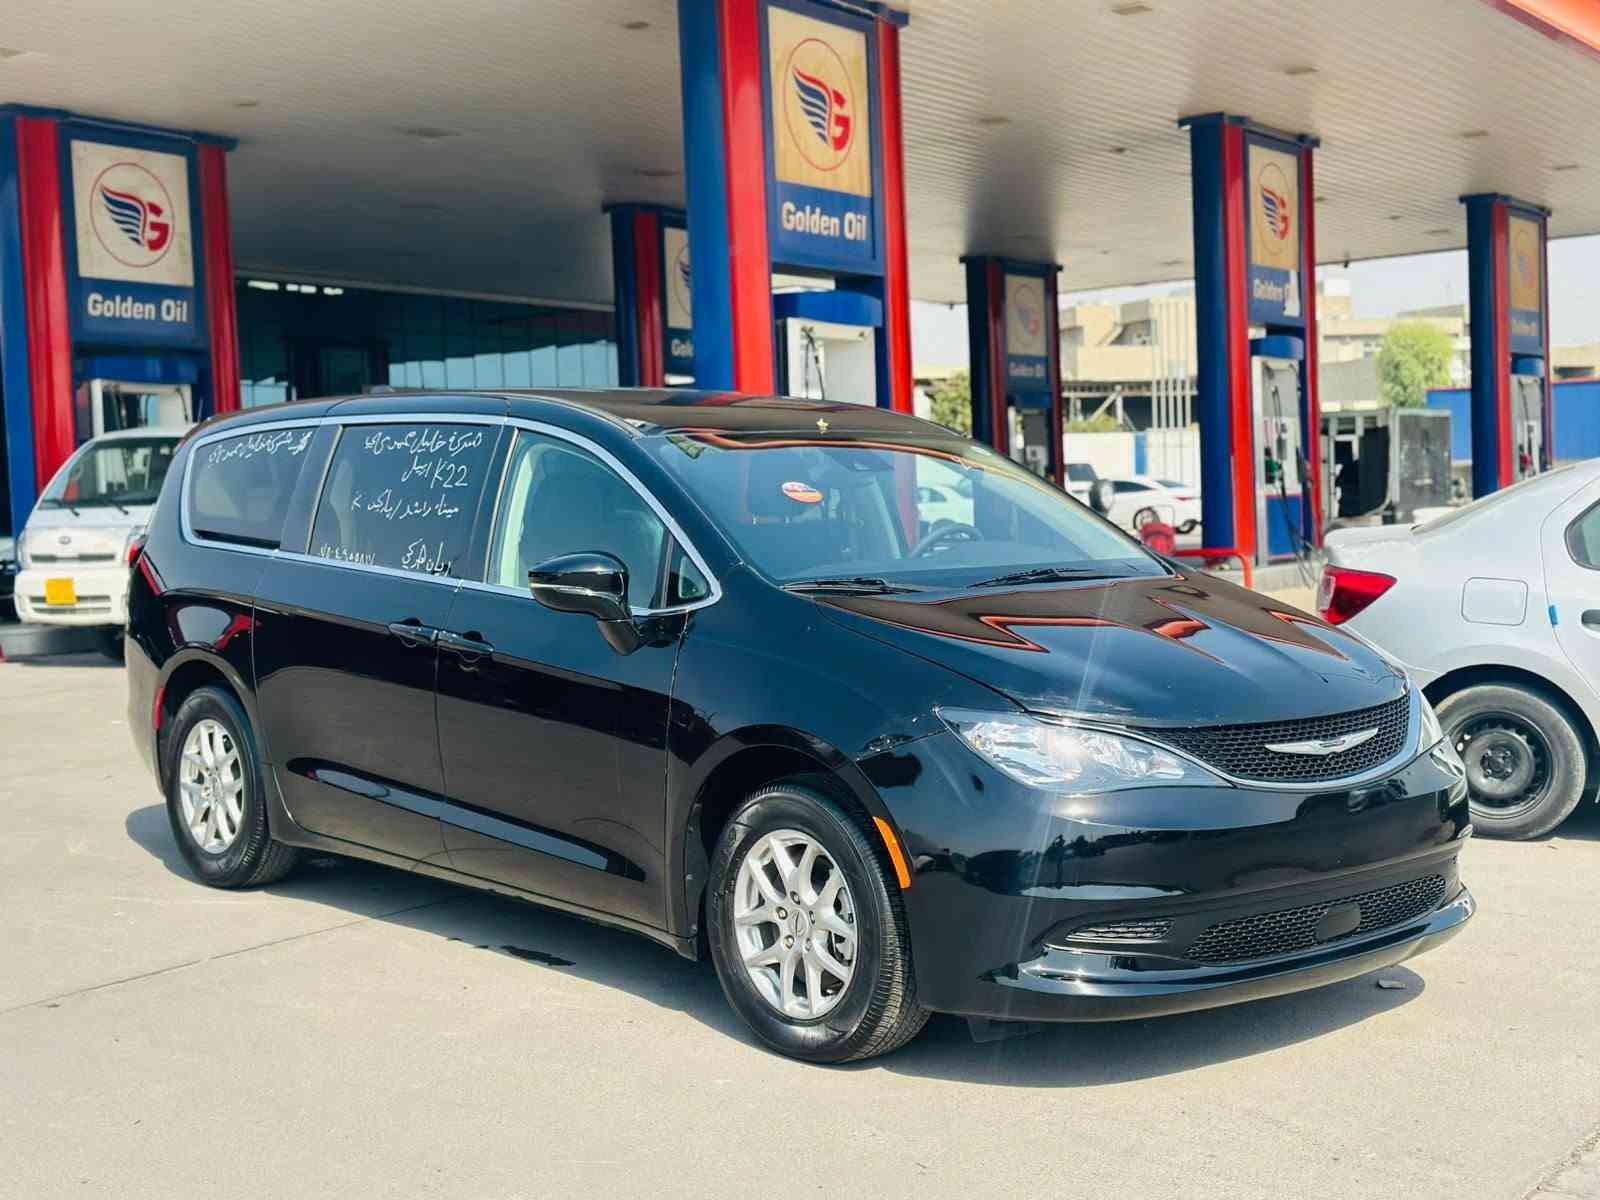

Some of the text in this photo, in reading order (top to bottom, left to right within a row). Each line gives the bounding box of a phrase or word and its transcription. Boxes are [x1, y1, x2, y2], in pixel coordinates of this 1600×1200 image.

[781, 201, 868, 240] Golden Oil
[87, 293, 188, 323] Golden Oil
[430, 457, 469, 489] K22
